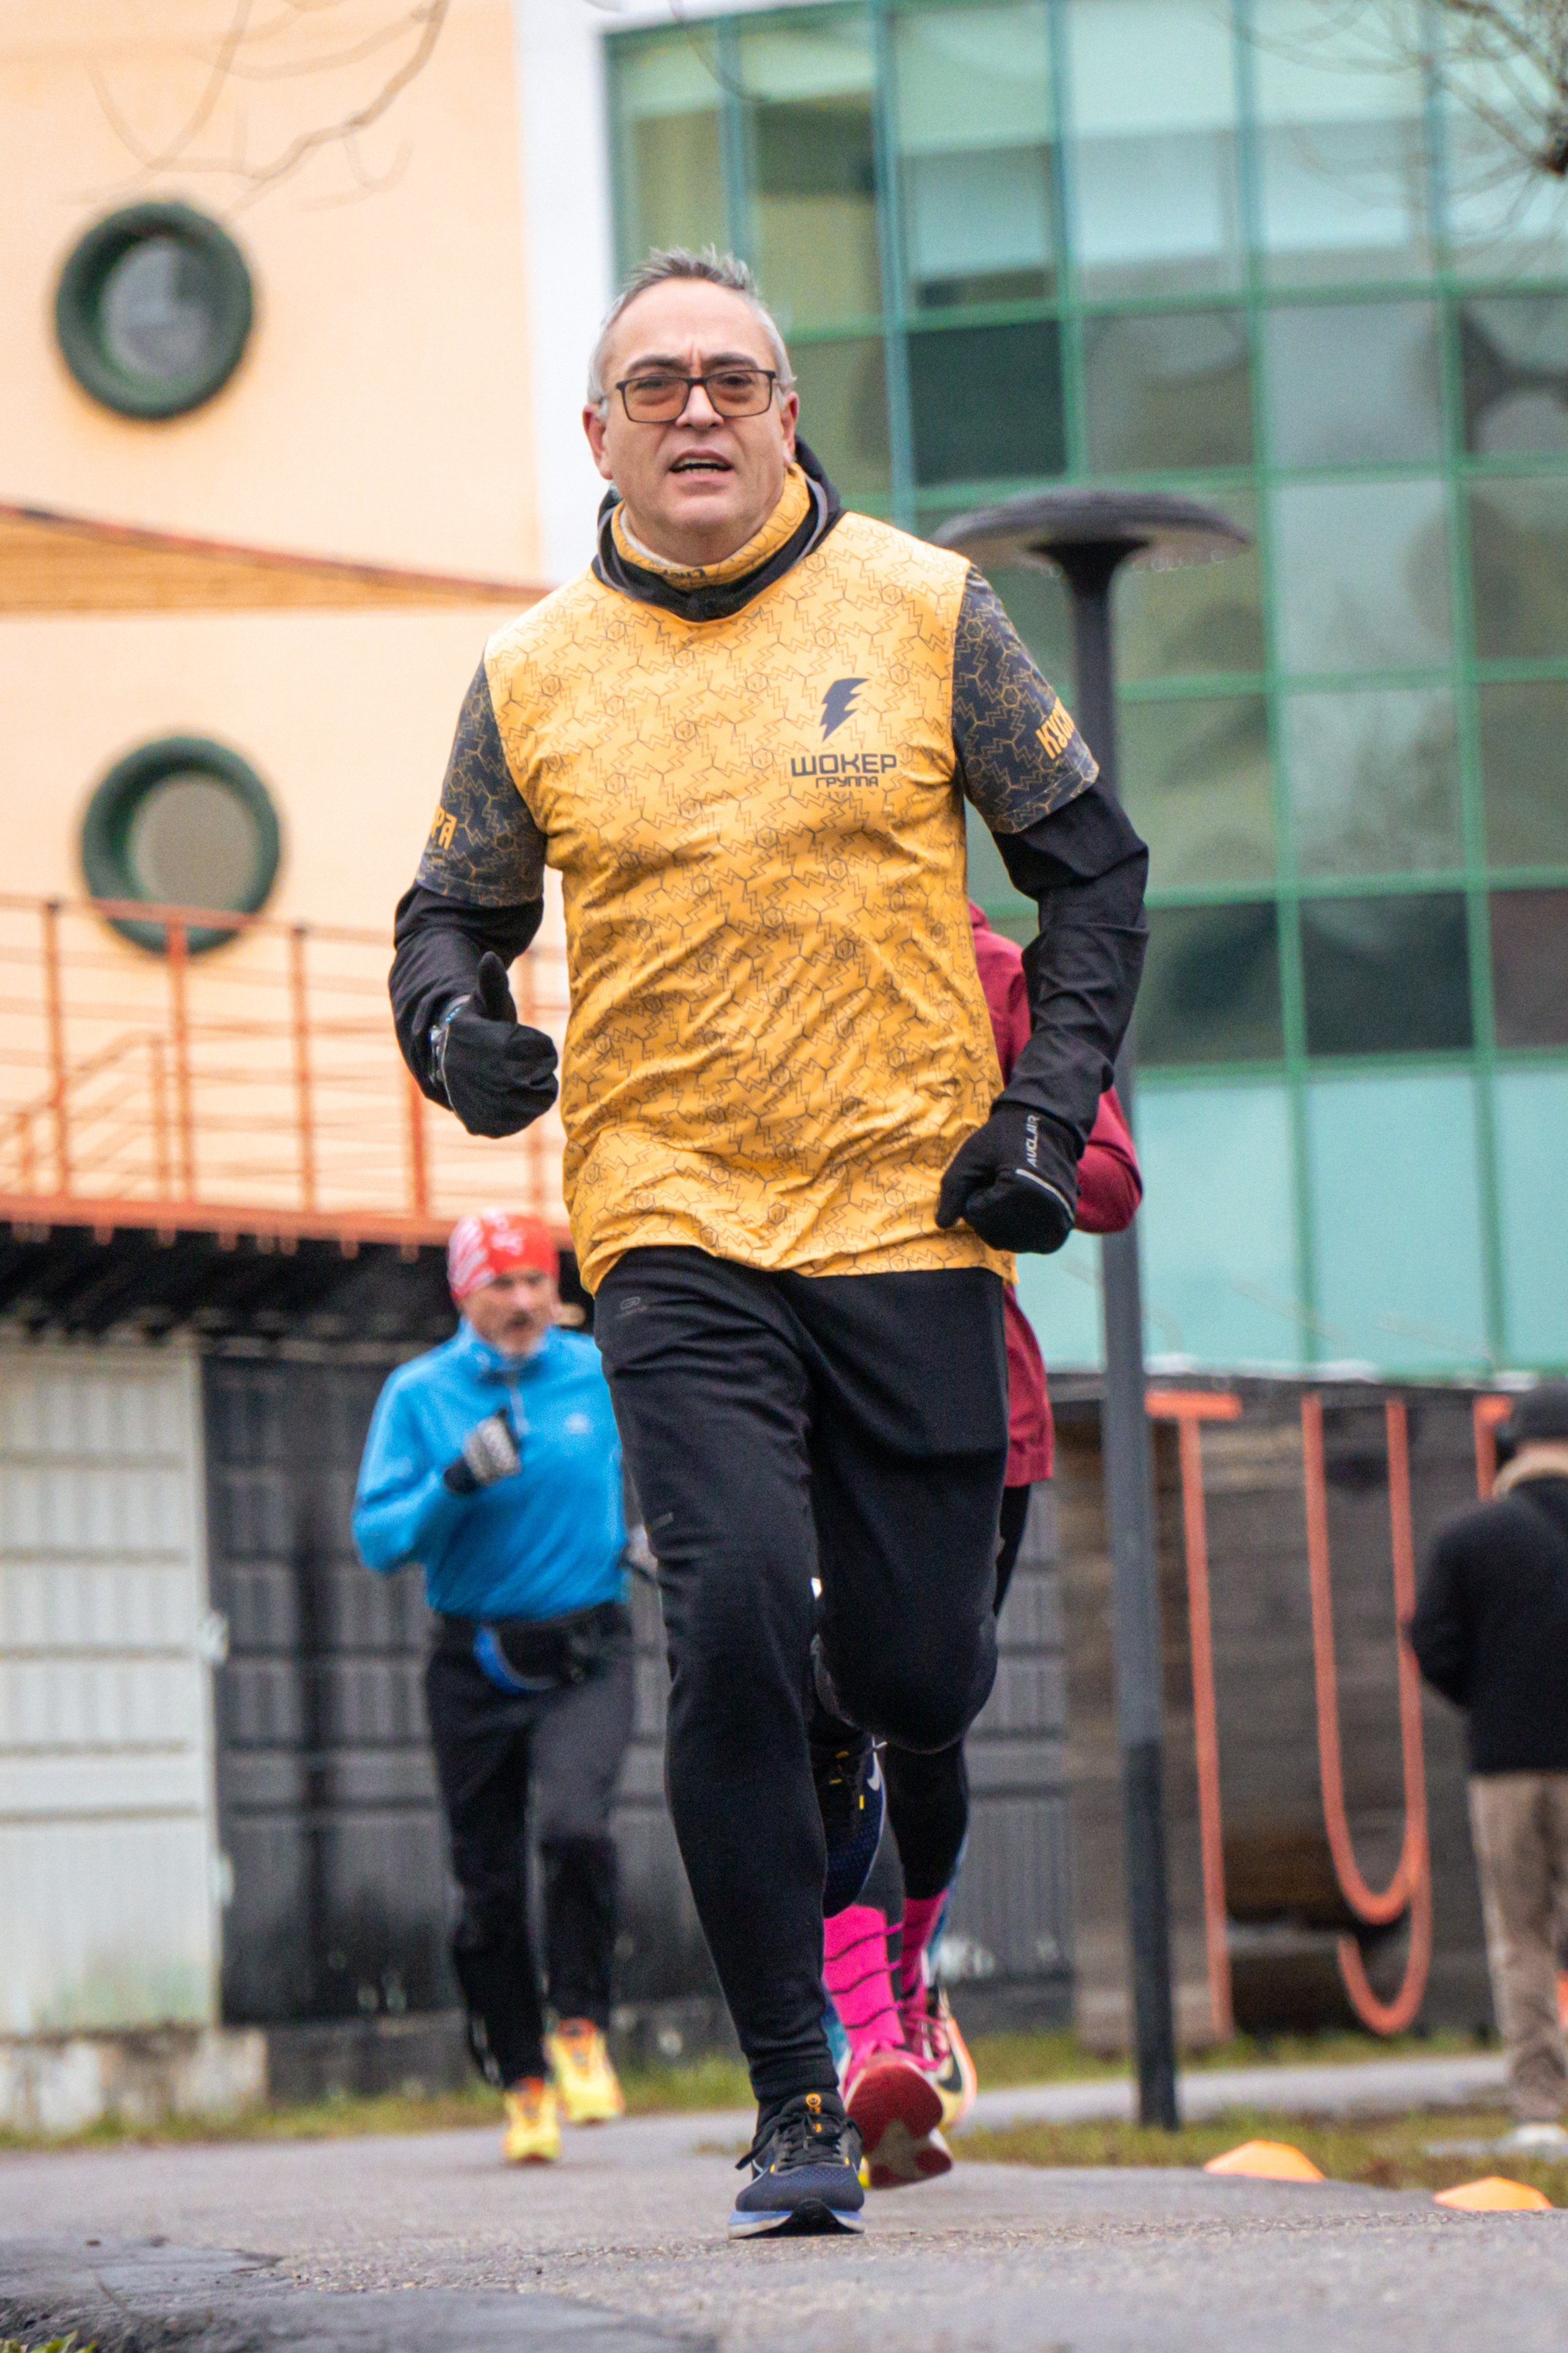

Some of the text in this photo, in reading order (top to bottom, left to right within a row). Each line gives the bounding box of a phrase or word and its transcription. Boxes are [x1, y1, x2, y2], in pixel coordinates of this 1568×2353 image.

[791, 753, 897, 777] ШОКЕР
[816, 776, 879, 788] ГРУППА
[430, 805, 458, 850] РА
[1026, 1114, 1041, 1168] AUCLAIR
